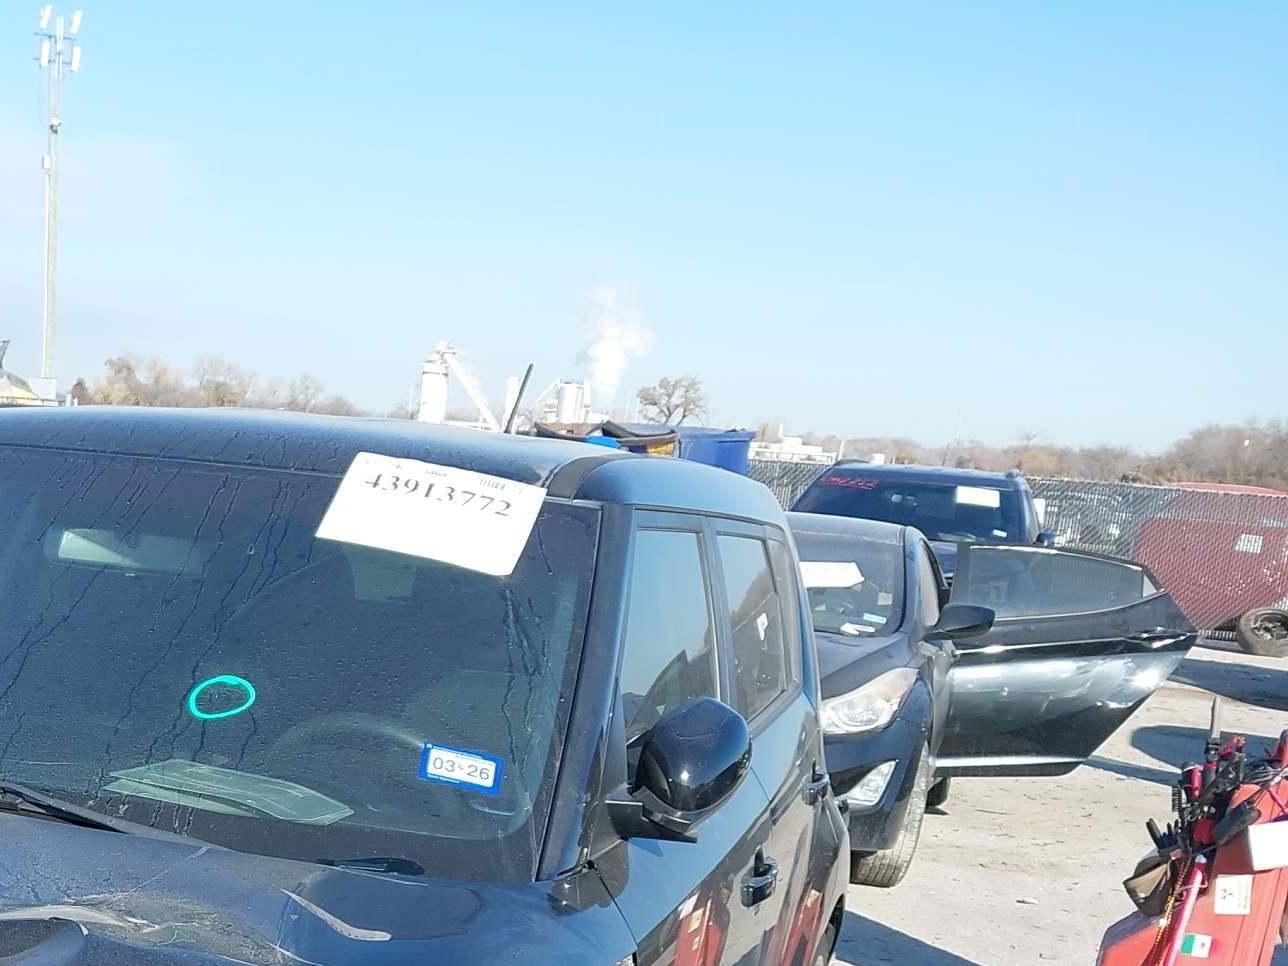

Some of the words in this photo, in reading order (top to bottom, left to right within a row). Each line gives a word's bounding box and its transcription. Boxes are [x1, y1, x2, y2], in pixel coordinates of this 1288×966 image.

[365, 473, 512, 517] 43913772
[432, 757, 456, 773] 03
[466, 764, 490, 781] 26
